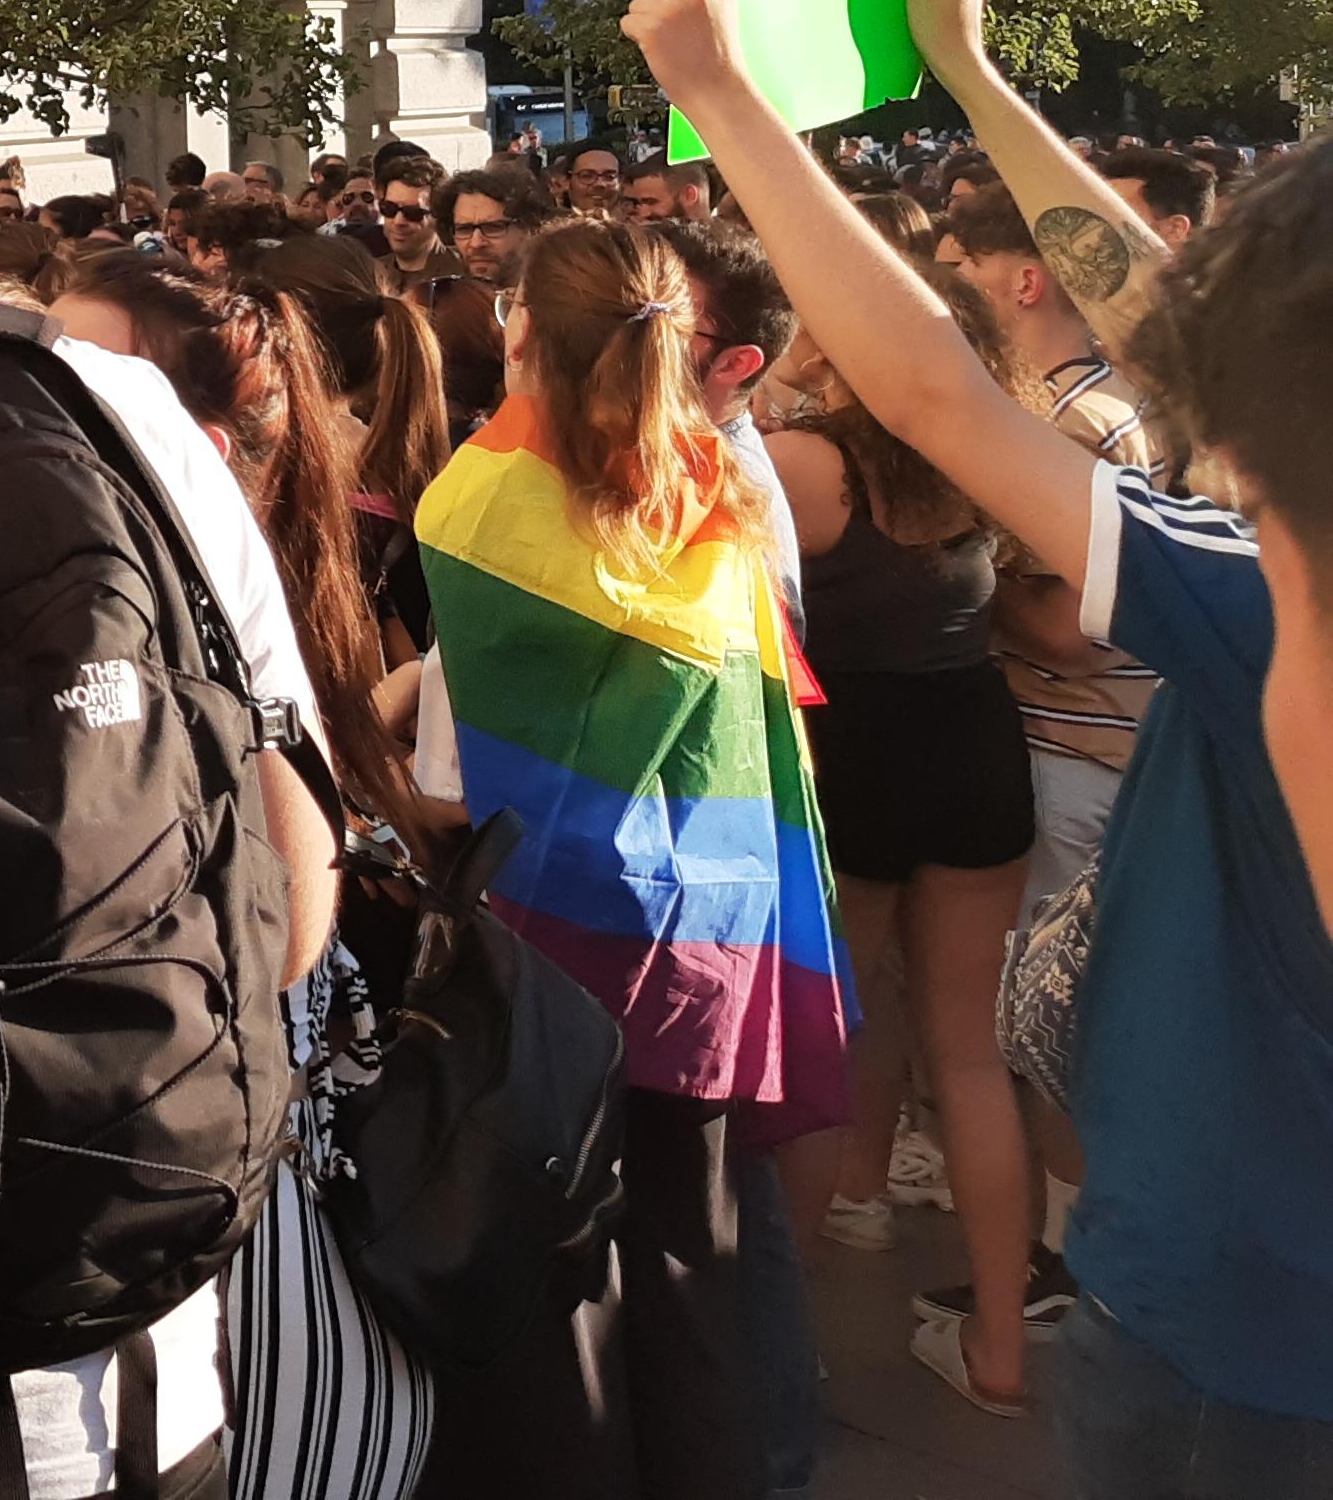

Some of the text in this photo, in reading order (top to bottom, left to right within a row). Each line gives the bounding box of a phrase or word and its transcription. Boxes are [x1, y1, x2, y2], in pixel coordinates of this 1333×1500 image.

[80, 660, 120, 684] THE
[53, 682, 120, 712] NORTH
[85, 703, 123, 729] FACE
